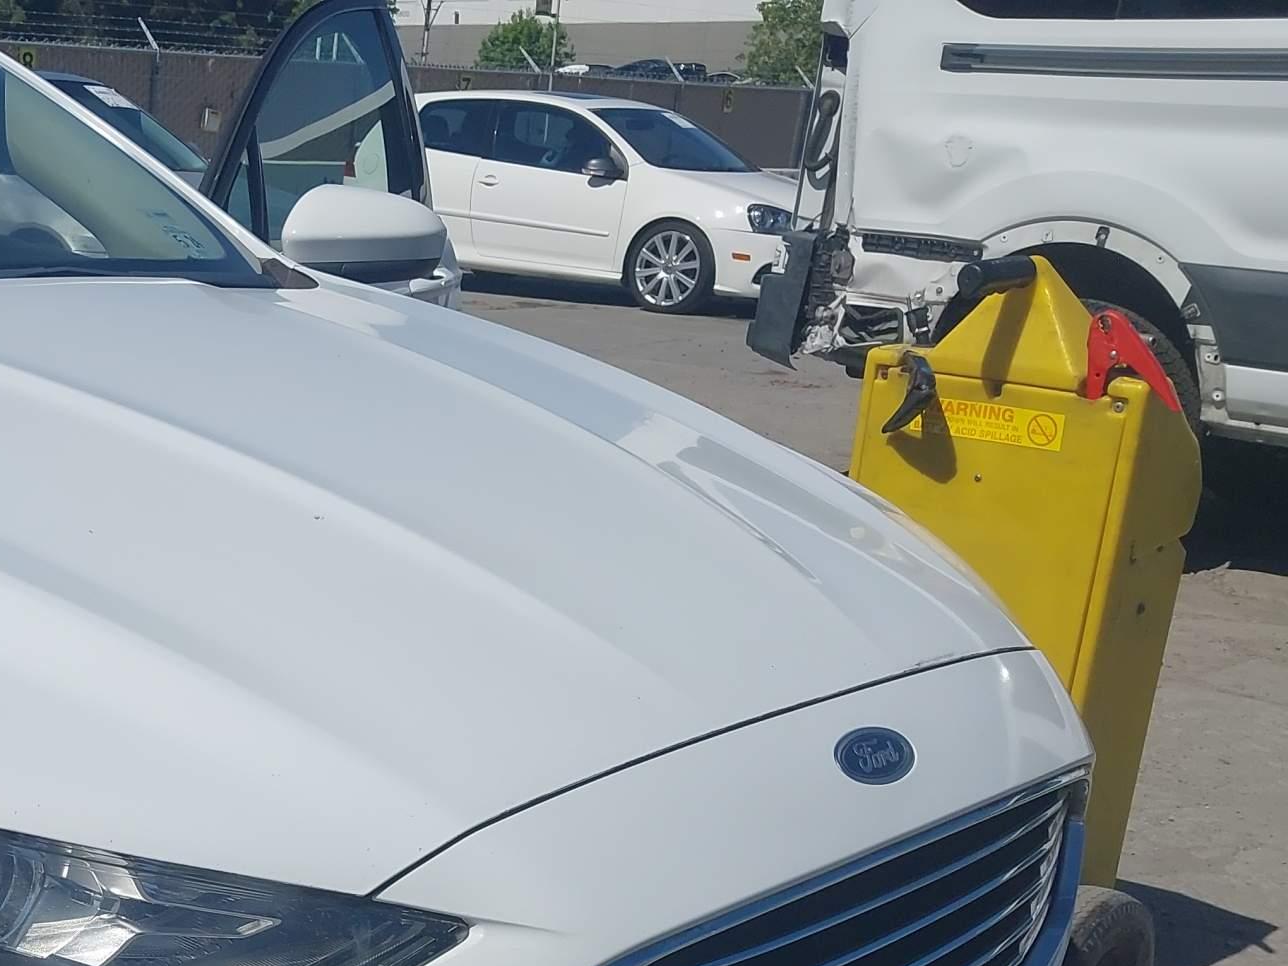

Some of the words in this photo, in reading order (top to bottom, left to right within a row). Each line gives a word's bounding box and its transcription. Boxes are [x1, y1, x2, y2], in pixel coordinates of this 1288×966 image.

[953, 424, 977, 437] ACID
[978, 428, 1024, 444] SPILLAGE
[852, 737, 900, 774] Ford
